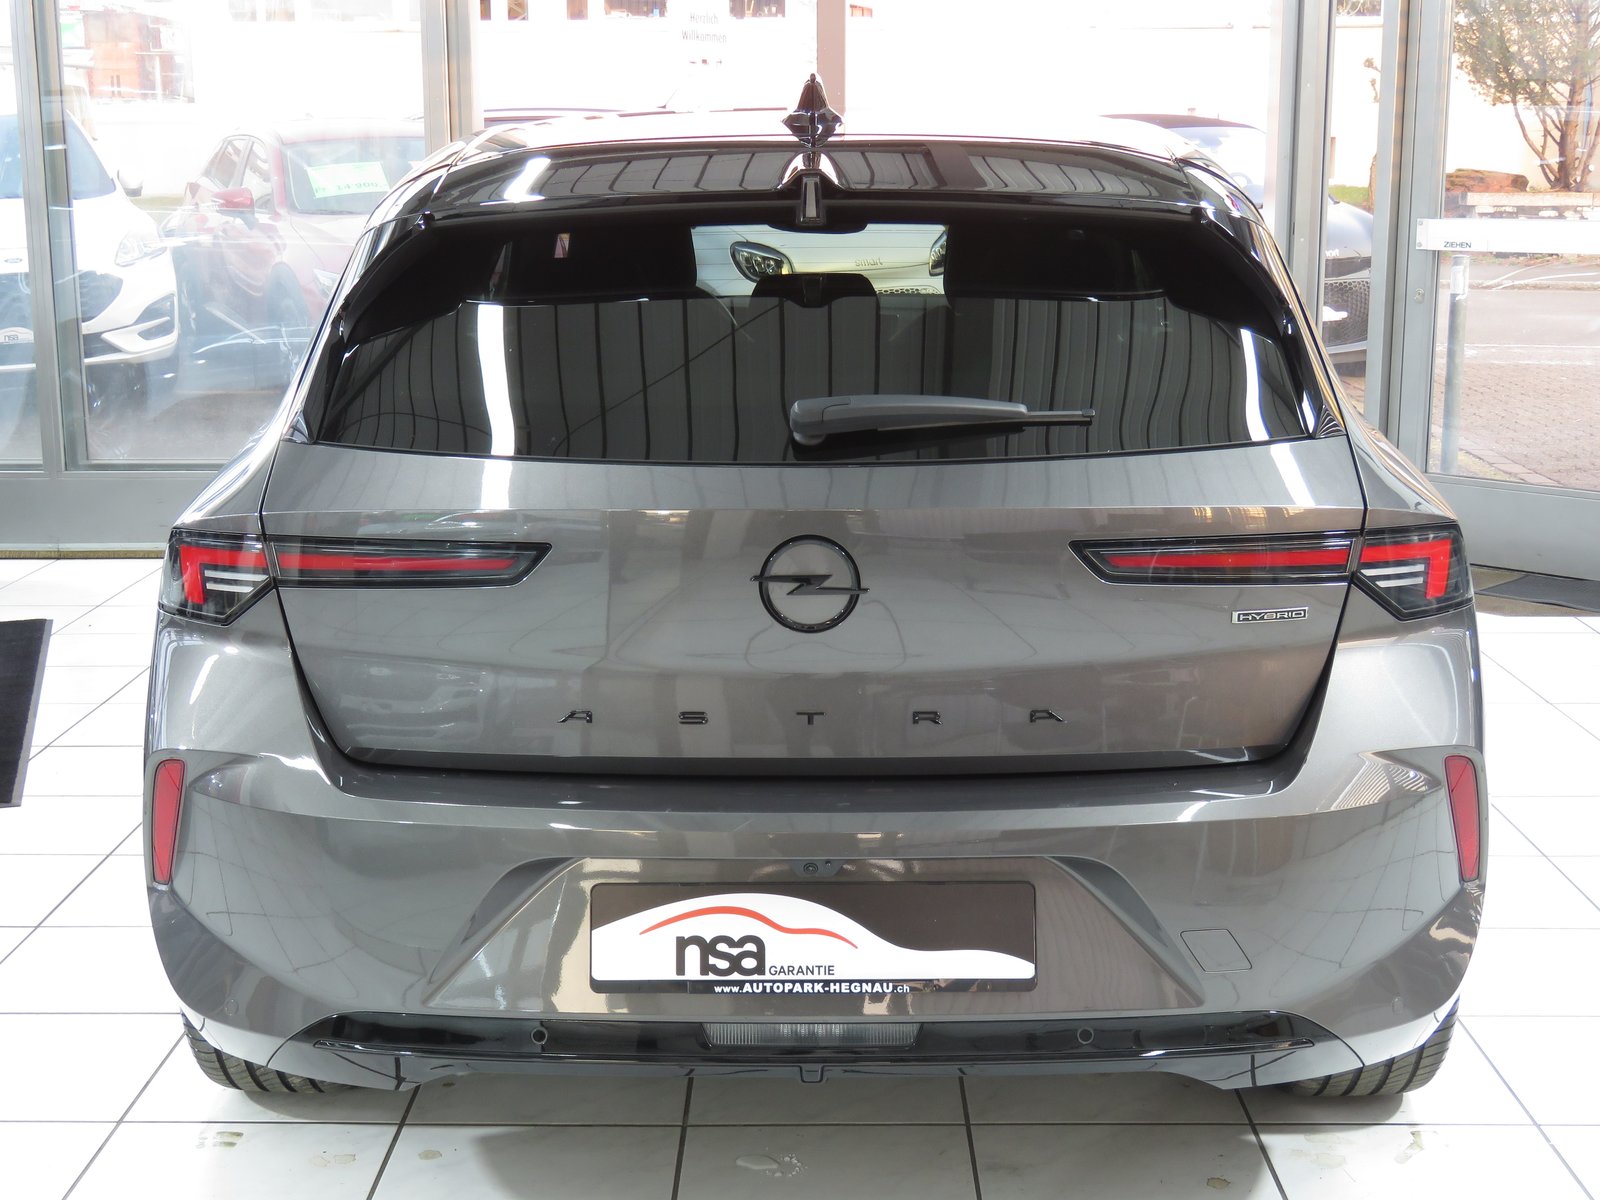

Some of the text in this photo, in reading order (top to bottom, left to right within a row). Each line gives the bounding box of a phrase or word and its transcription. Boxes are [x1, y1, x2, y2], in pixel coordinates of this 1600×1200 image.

[690, 11, 719, 24] Herzlich
[681, 29, 727, 43] Willkommen
[1443, 241, 1472, 249] ZIEHEN
[1239, 610, 1305, 621] HYBRID
[557, 709, 1065, 725] ASTRA
[675, 934, 835, 977] nsa GARANTIE
[713, 981, 910, 994] www.AUTOPARK-HEGNAU.ch
